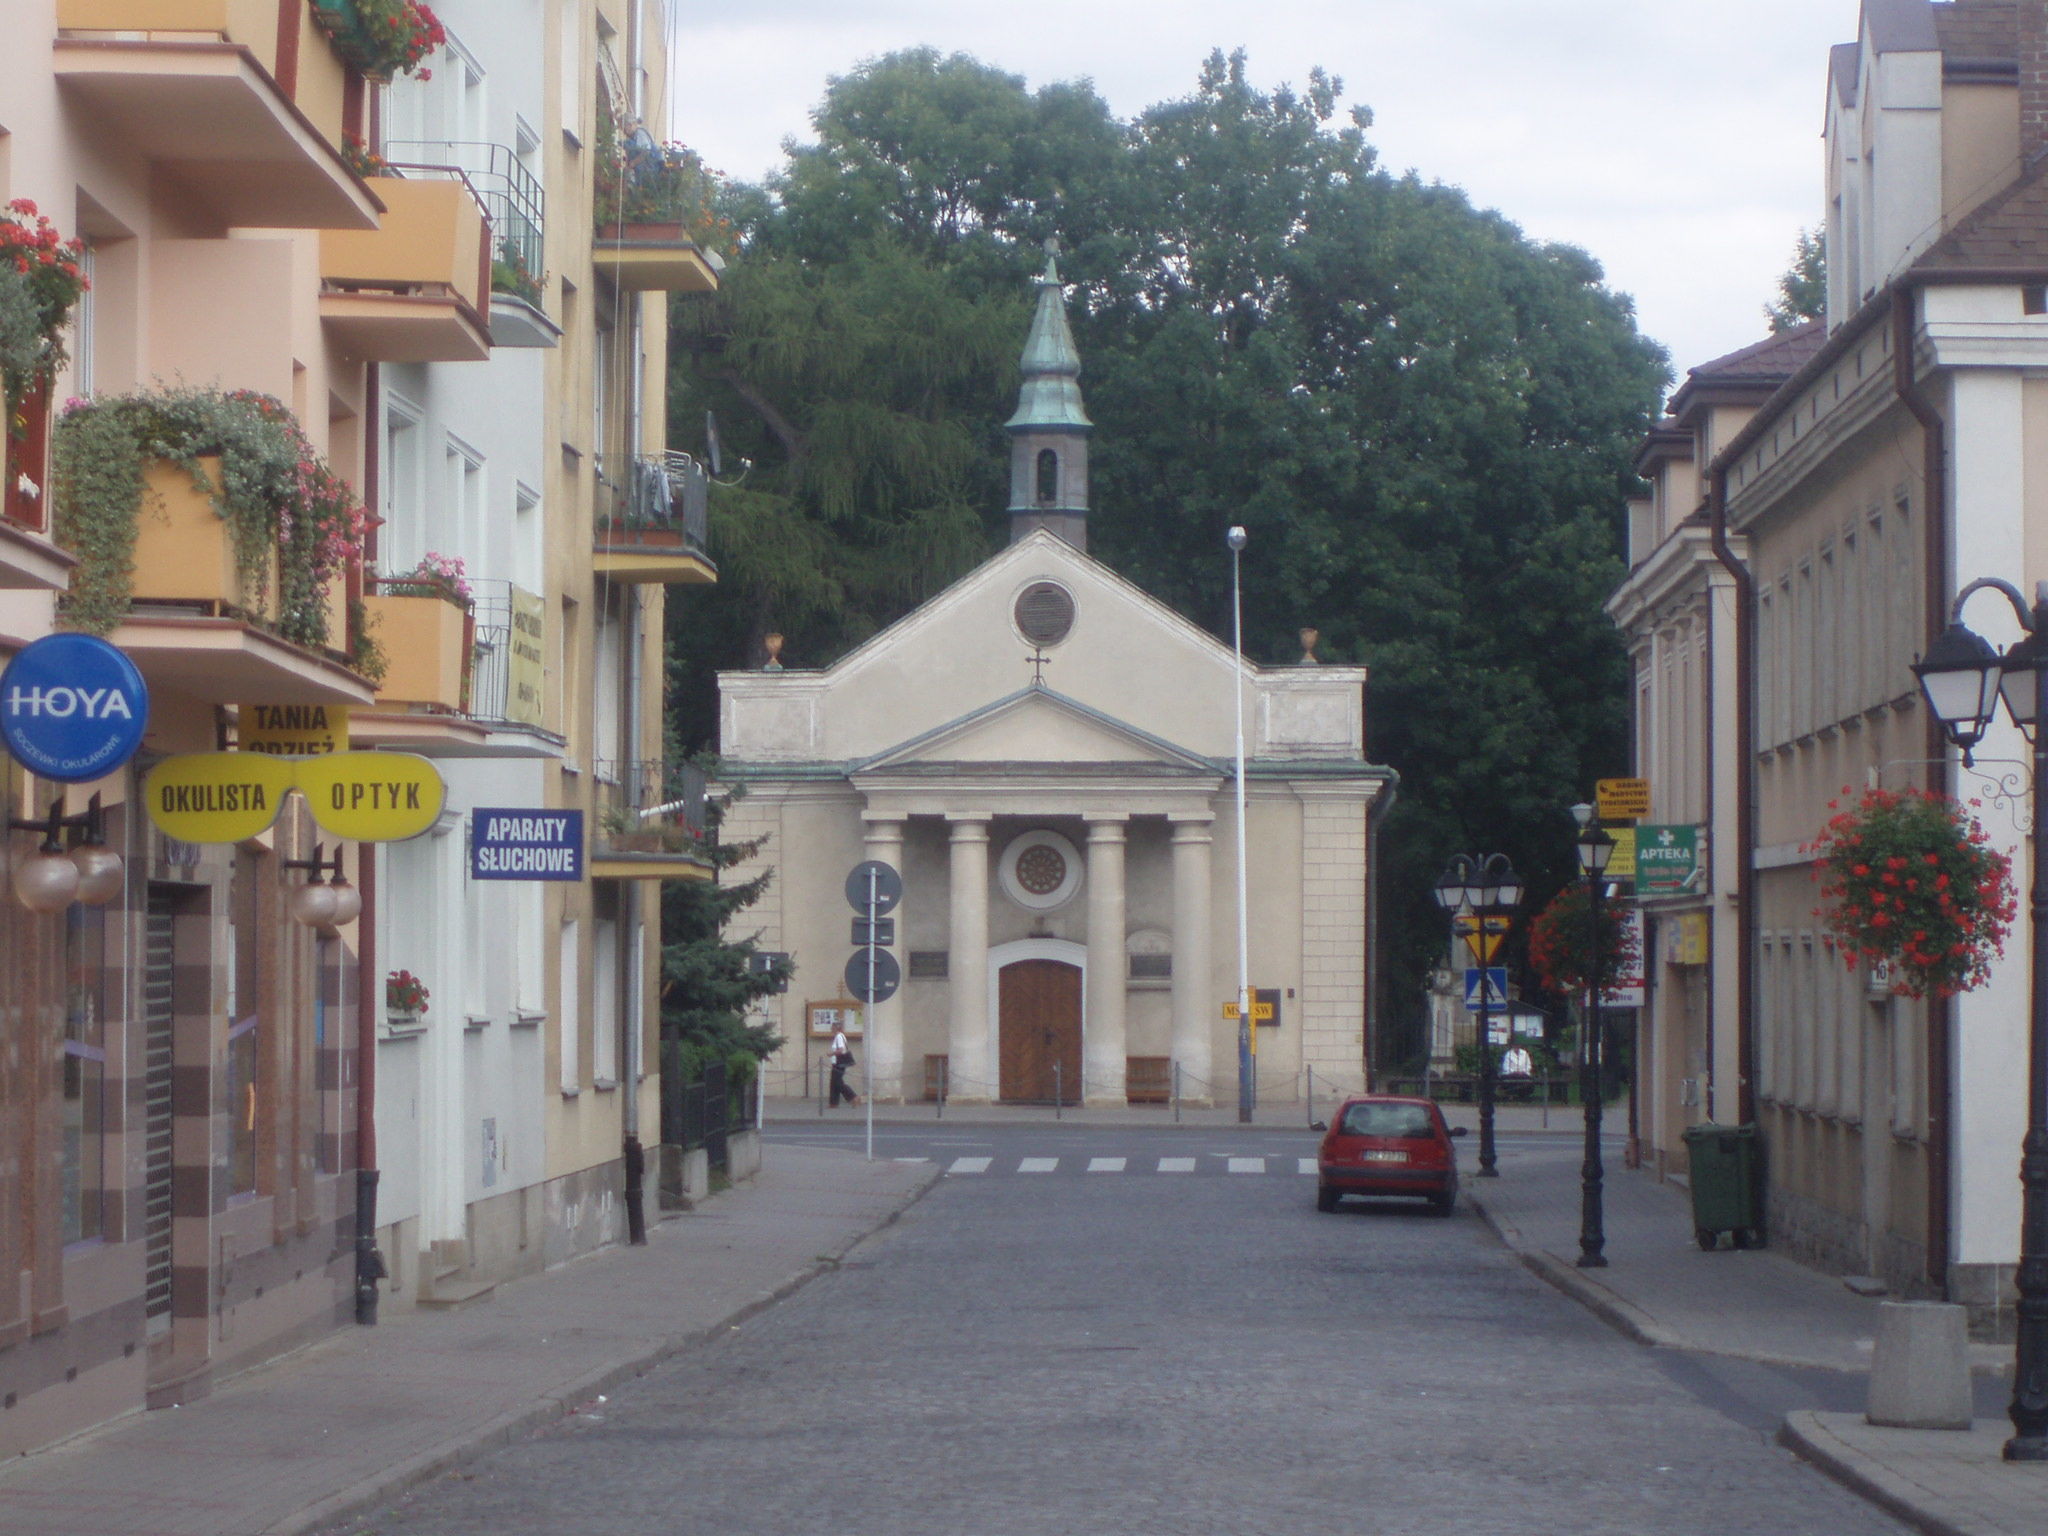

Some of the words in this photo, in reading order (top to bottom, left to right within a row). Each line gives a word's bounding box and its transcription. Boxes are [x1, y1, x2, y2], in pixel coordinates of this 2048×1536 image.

[8, 685, 132, 720] HOYA
[254, 704, 329, 730] TANIA
[14, 728, 58, 768] SOCZEWKI
[62, 734, 121, 769] OKULAROWE
[161, 784, 266, 813] OKULISTA
[331, 782, 420, 810] OPTYK
[486, 817, 567, 842] APARATY
[478, 847, 574, 873] SŁUCHOWE
[1640, 848, 1690, 860] APTEKA
